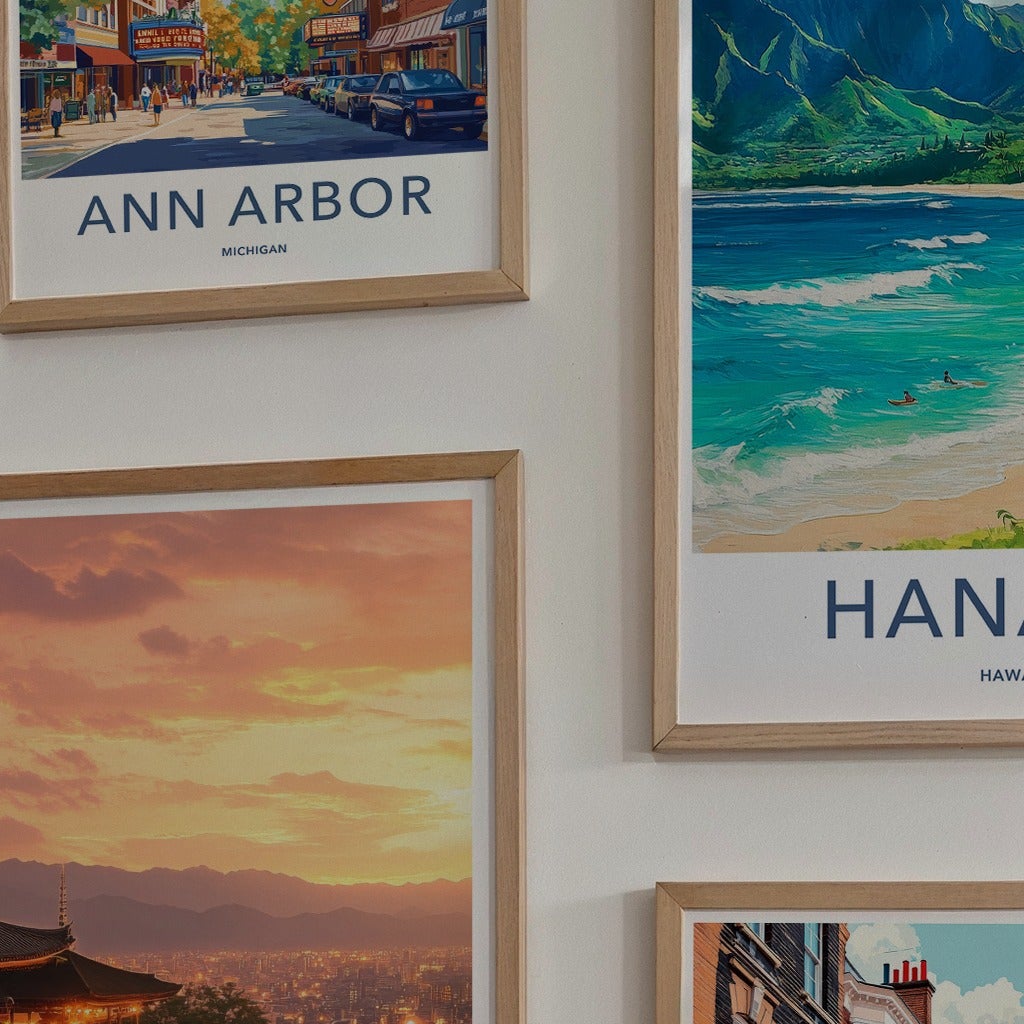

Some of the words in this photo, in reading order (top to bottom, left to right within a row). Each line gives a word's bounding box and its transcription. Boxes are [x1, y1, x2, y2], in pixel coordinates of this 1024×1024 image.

[77, 189, 204, 236] ANN
[229, 175, 432, 227] ARBOR
[221, 243, 288, 257] MICHIGAN
[827, 577, 1024, 639] HAN
[980, 669, 1024, 682] HAW
